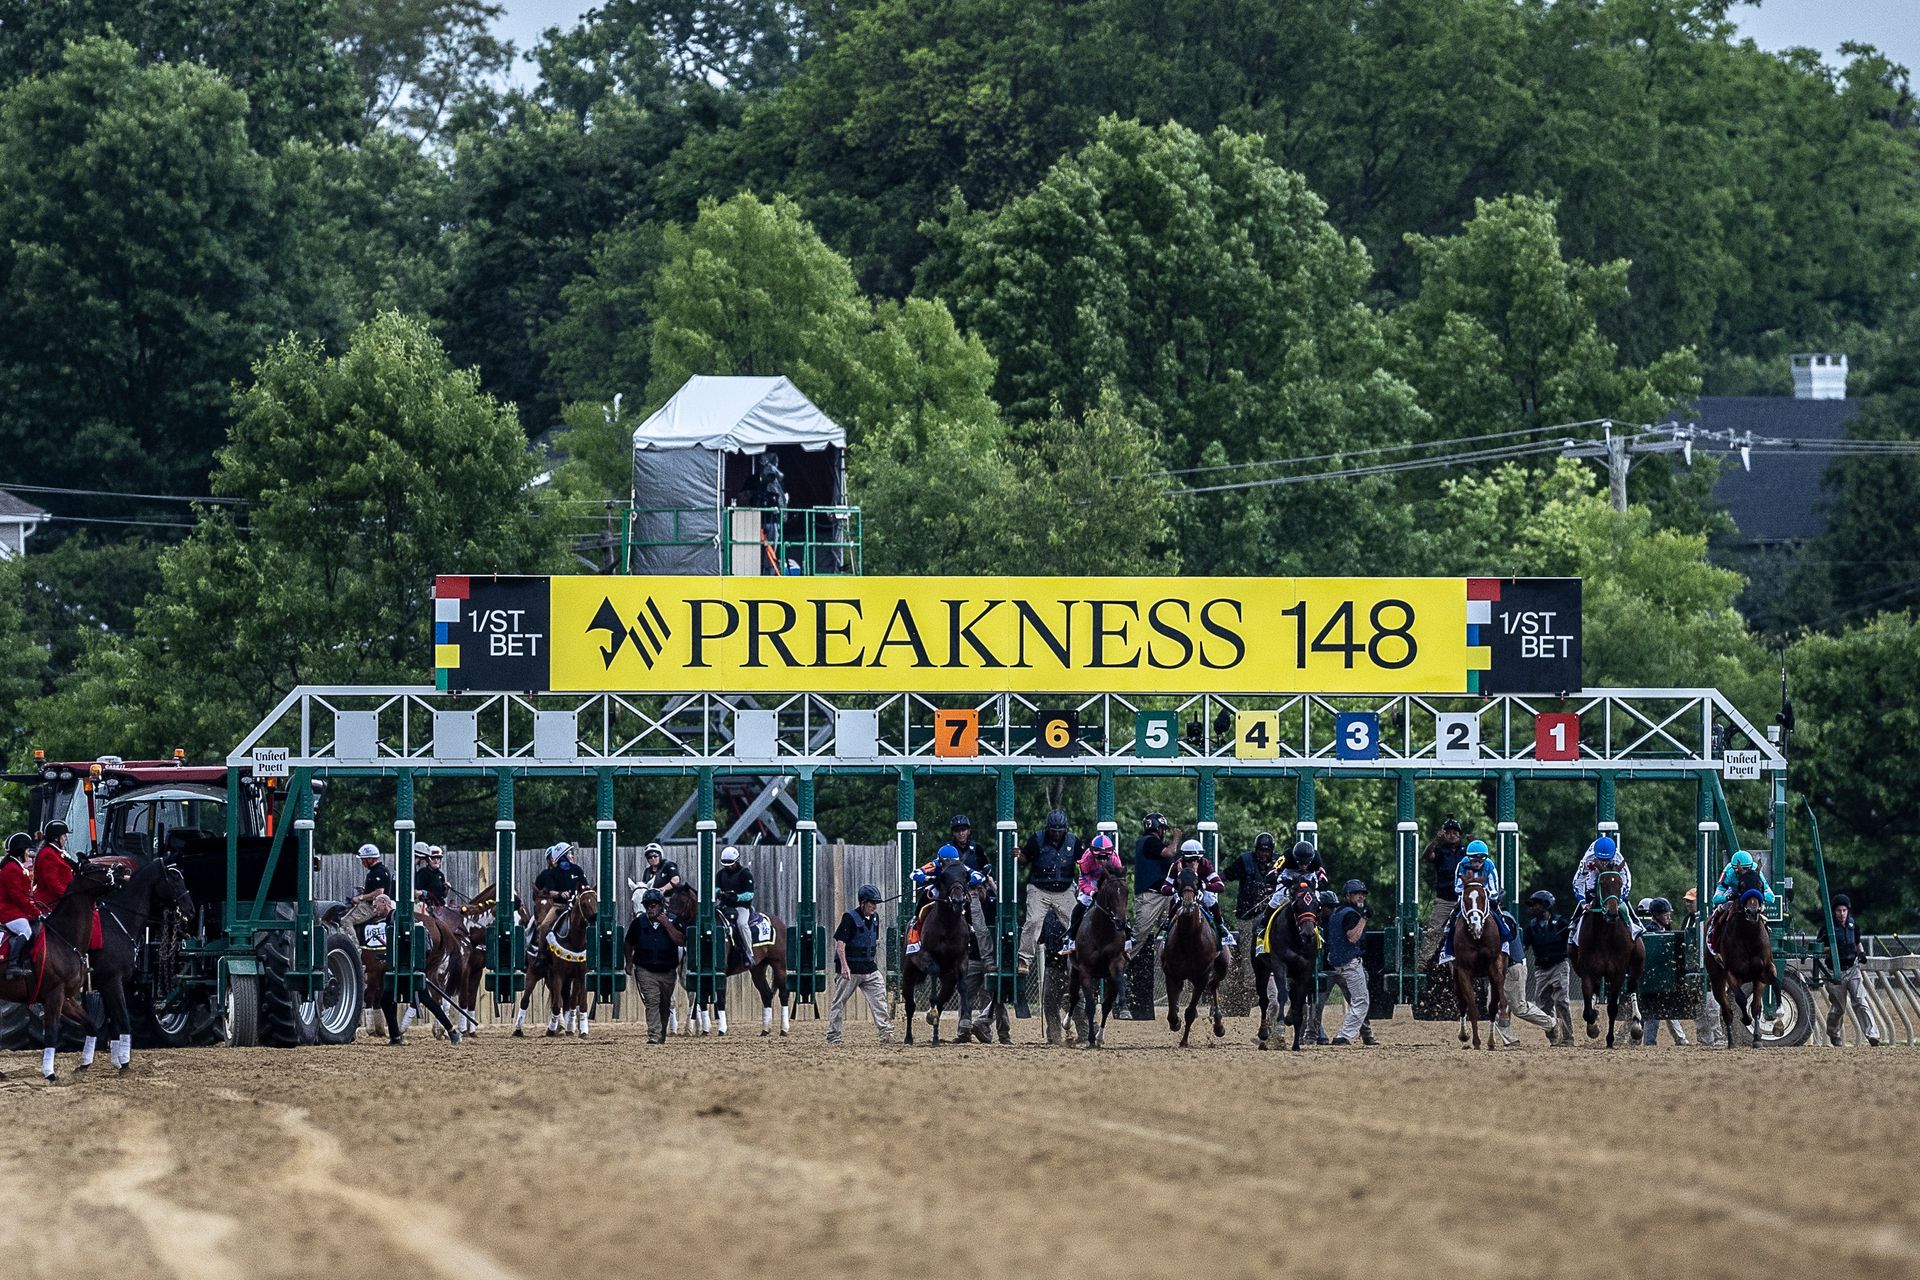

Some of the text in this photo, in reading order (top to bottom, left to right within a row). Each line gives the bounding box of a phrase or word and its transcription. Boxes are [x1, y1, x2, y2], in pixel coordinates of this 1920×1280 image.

[468, 610, 525, 633] 1/ST
[682, 599, 1418, 669] PREAKNESS 148
[1500, 612, 1556, 635] 1/ST
[490, 634, 543, 657] BET
[1522, 635, 1574, 658] BET
[945, 719, 968, 747] 7
[1045, 719, 1070, 749] 6
[1145, 720, 1169, 749] 5
[1245, 721, 1270, 749] 4
[1346, 721, 1370, 750] 3
[1446, 722, 1470, 751] 2
[1549, 723, 1566, 752] 1
[255, 752, 286, 761] United
[258, 763, 283, 772] Puett
[1726, 755, 1757, 764] United
[1730, 765, 1754, 774] Puett
